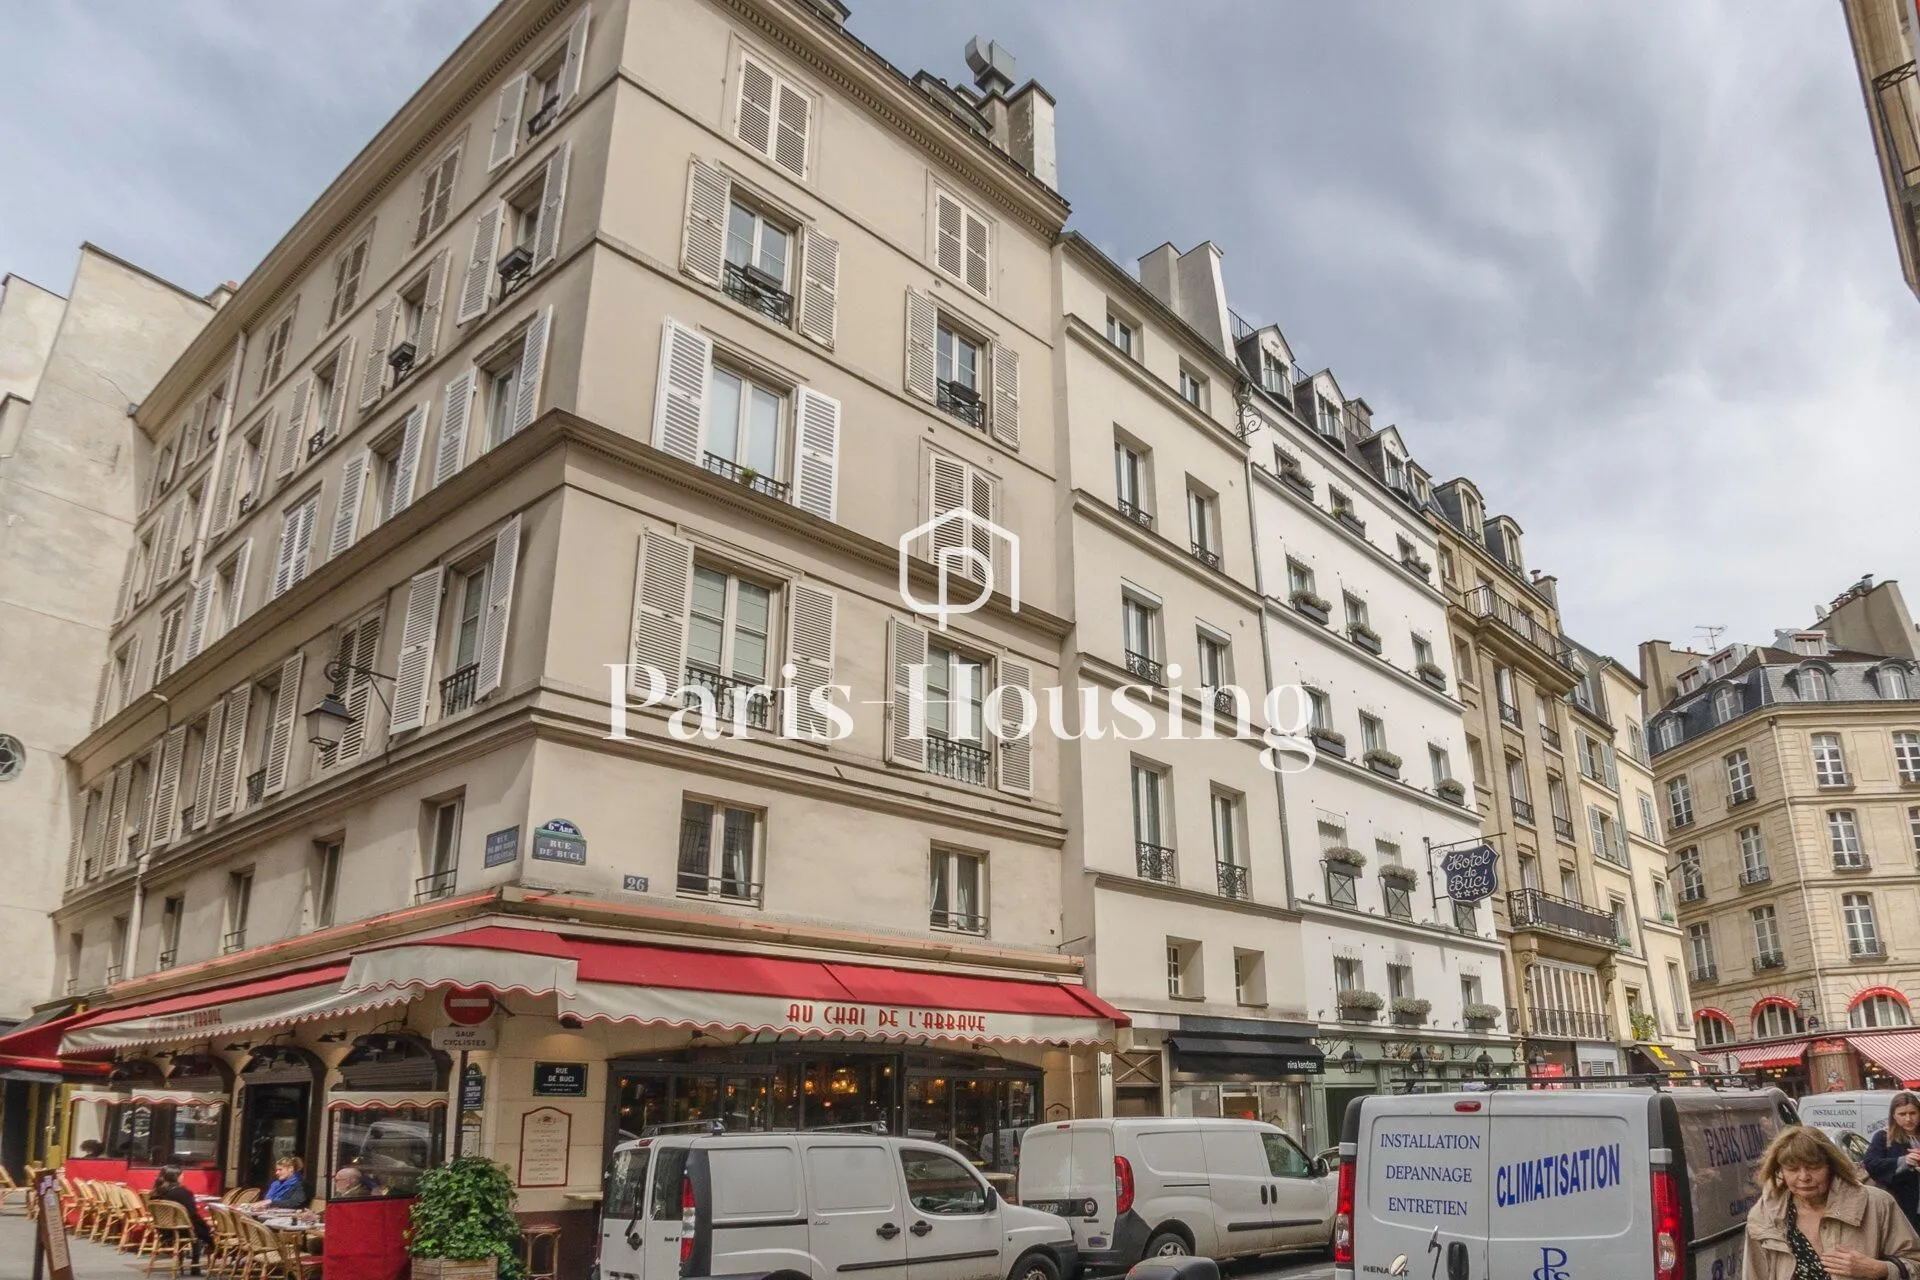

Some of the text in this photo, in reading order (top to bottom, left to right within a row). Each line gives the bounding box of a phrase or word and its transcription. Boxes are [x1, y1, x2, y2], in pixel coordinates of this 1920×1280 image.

[550, 840, 572, 850] RUE
[540, 847, 581, 861] DE BUCI
[1463, 867, 1477, 878] de
[626, 876, 645, 891] 26
[1449, 869, 1490, 892] Buci
[787, 1004, 985, 1032] AU CHAI DE L'ABBAYE
[443, 1039, 486, 1047] CYCLISTES
[555, 1067, 568, 1075] RUE
[548, 1075, 558, 1083] DE
[1813, 1109, 1857, 1117] INSTALLATION
[1380, 1133, 1480, 1149] INSTALLATION
[1704, 1125, 1742, 1167] PARIS
[1386, 1165, 1472, 1183] DEPANNAGE
[1497, 1143, 1621, 1208] CLIMATISATION
[1388, 1197, 1467, 1216] ENTRETIEN
[1363, 1265, 1410, 1276] RENAT
